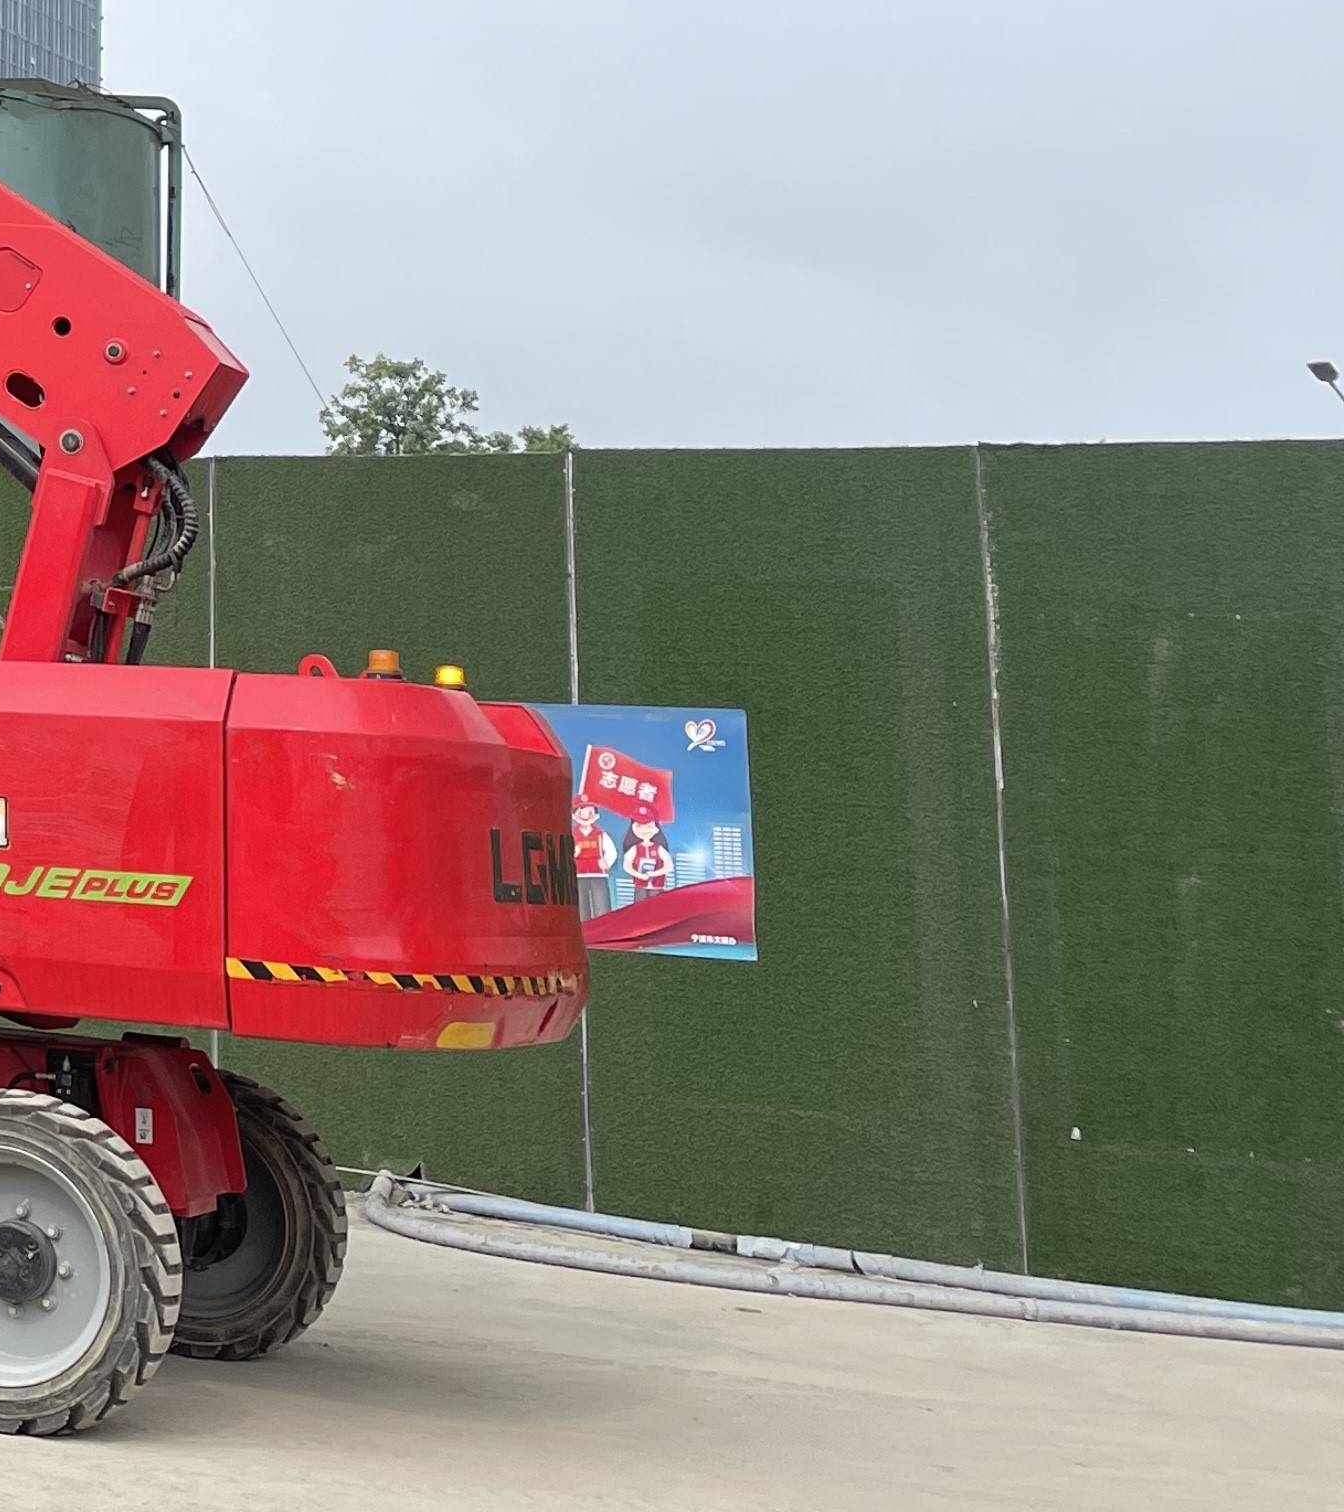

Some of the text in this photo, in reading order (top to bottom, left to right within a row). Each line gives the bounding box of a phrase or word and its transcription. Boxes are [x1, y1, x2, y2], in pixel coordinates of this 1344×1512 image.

[599, 770, 657, 803] 志愿者
[490, 828, 579, 905] LGM
